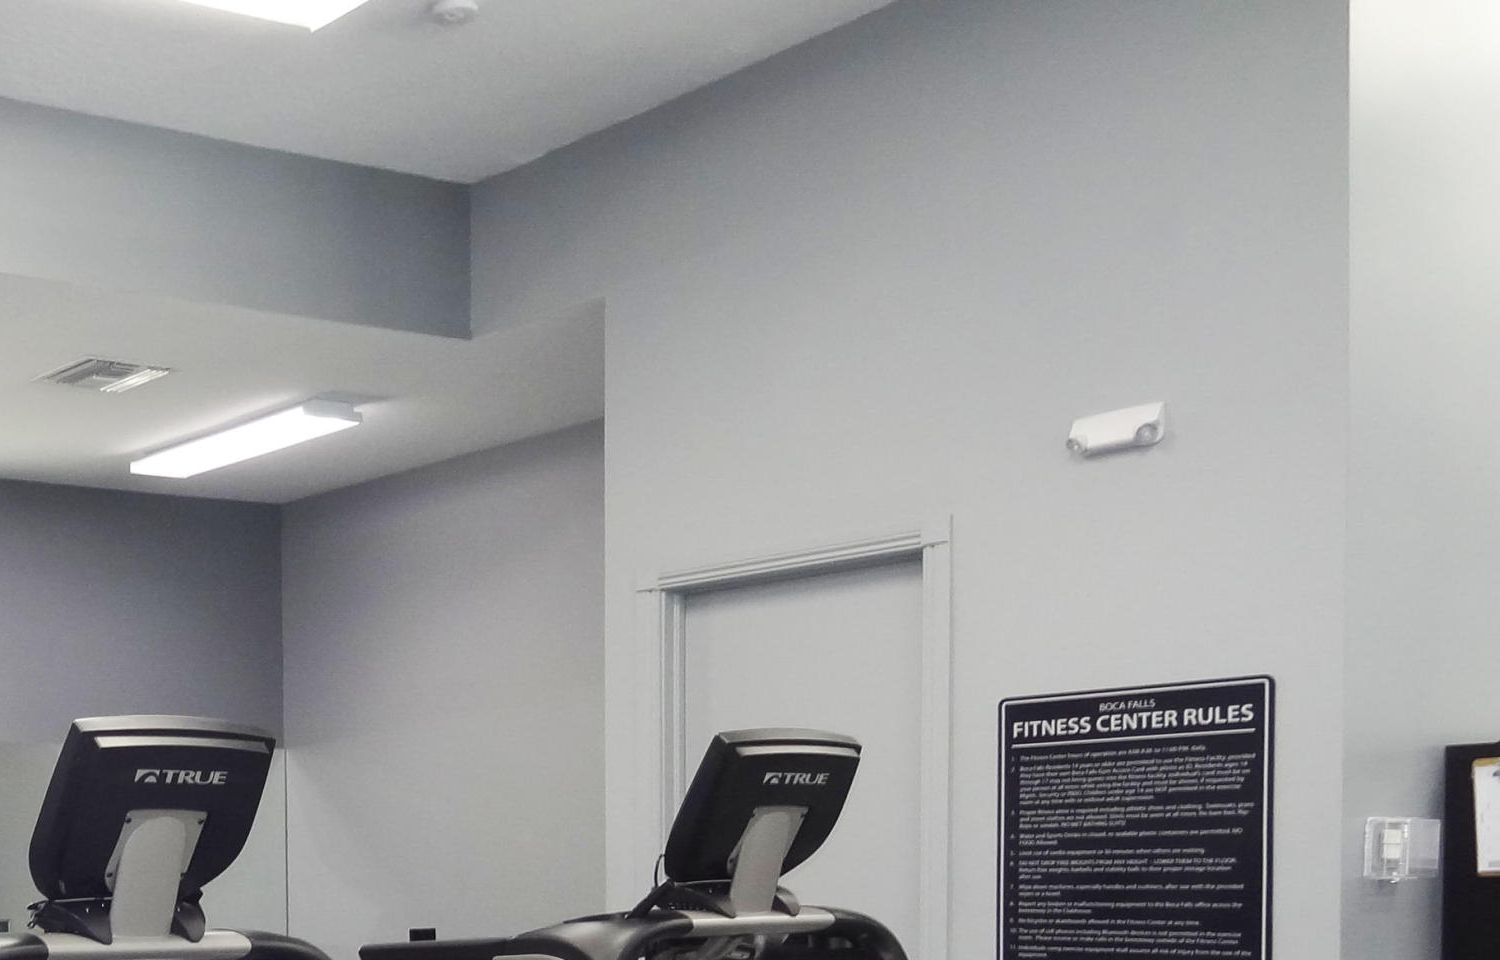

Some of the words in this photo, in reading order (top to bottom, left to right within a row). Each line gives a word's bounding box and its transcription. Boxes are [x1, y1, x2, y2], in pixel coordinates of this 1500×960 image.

[1099, 702, 1126, 712] BOCA
[1127, 699, 1156, 709] FALLS
[1013, 716, 1091, 738] FITNESS
[1096, 710, 1178, 732] CENTER
[1183, 703, 1254, 726] RULES
[162, 769, 228, 785] TRUE
[783, 772, 830, 785] TRUE
